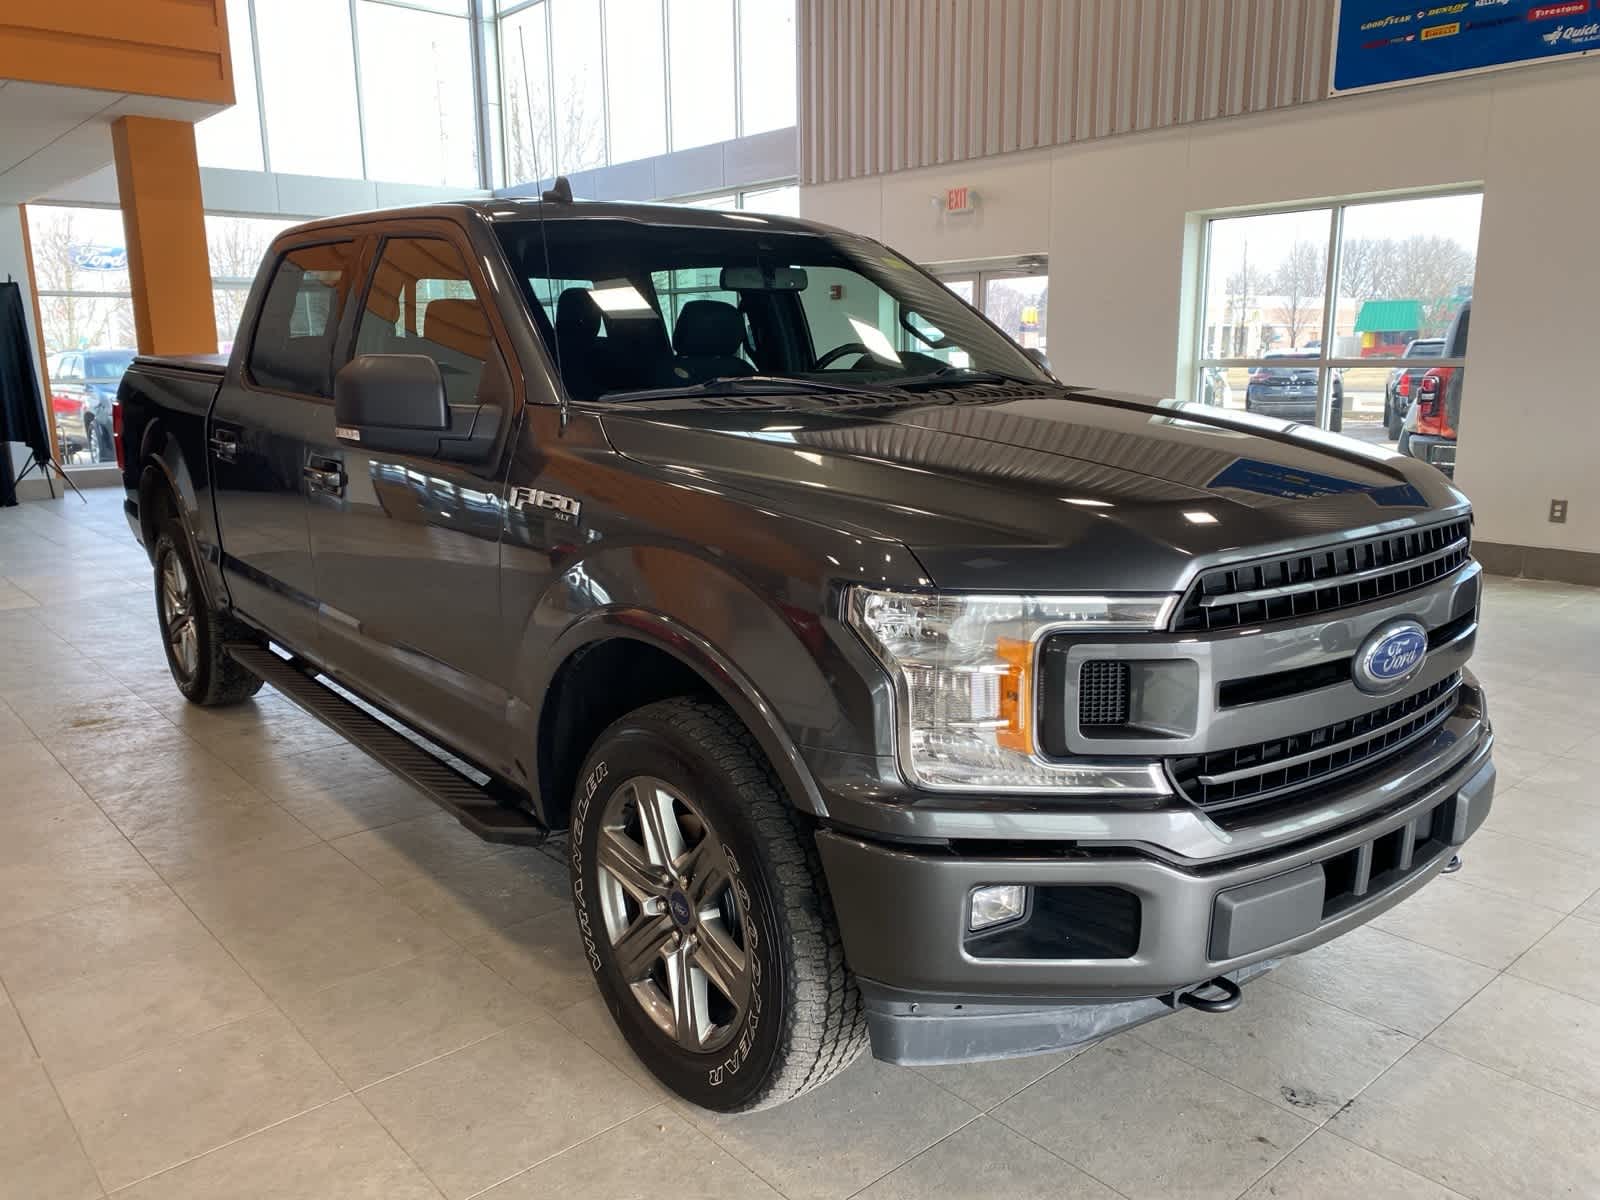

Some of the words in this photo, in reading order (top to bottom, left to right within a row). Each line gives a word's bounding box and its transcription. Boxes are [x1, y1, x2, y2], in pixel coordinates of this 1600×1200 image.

[1360, 14, 1412, 31] GOODYEAR
[1427, 2, 1470, 17] DUNLOP
[1535, 4, 1585, 18] Firestone
[1562, 23, 1599, 40] Quick
[948, 187, 968, 210] EXIT
[1383, 639, 1418, 672] Ford
[573, 761, 609, 972] WRANGLER
[709, 843, 762, 1086] GOODYEAR
